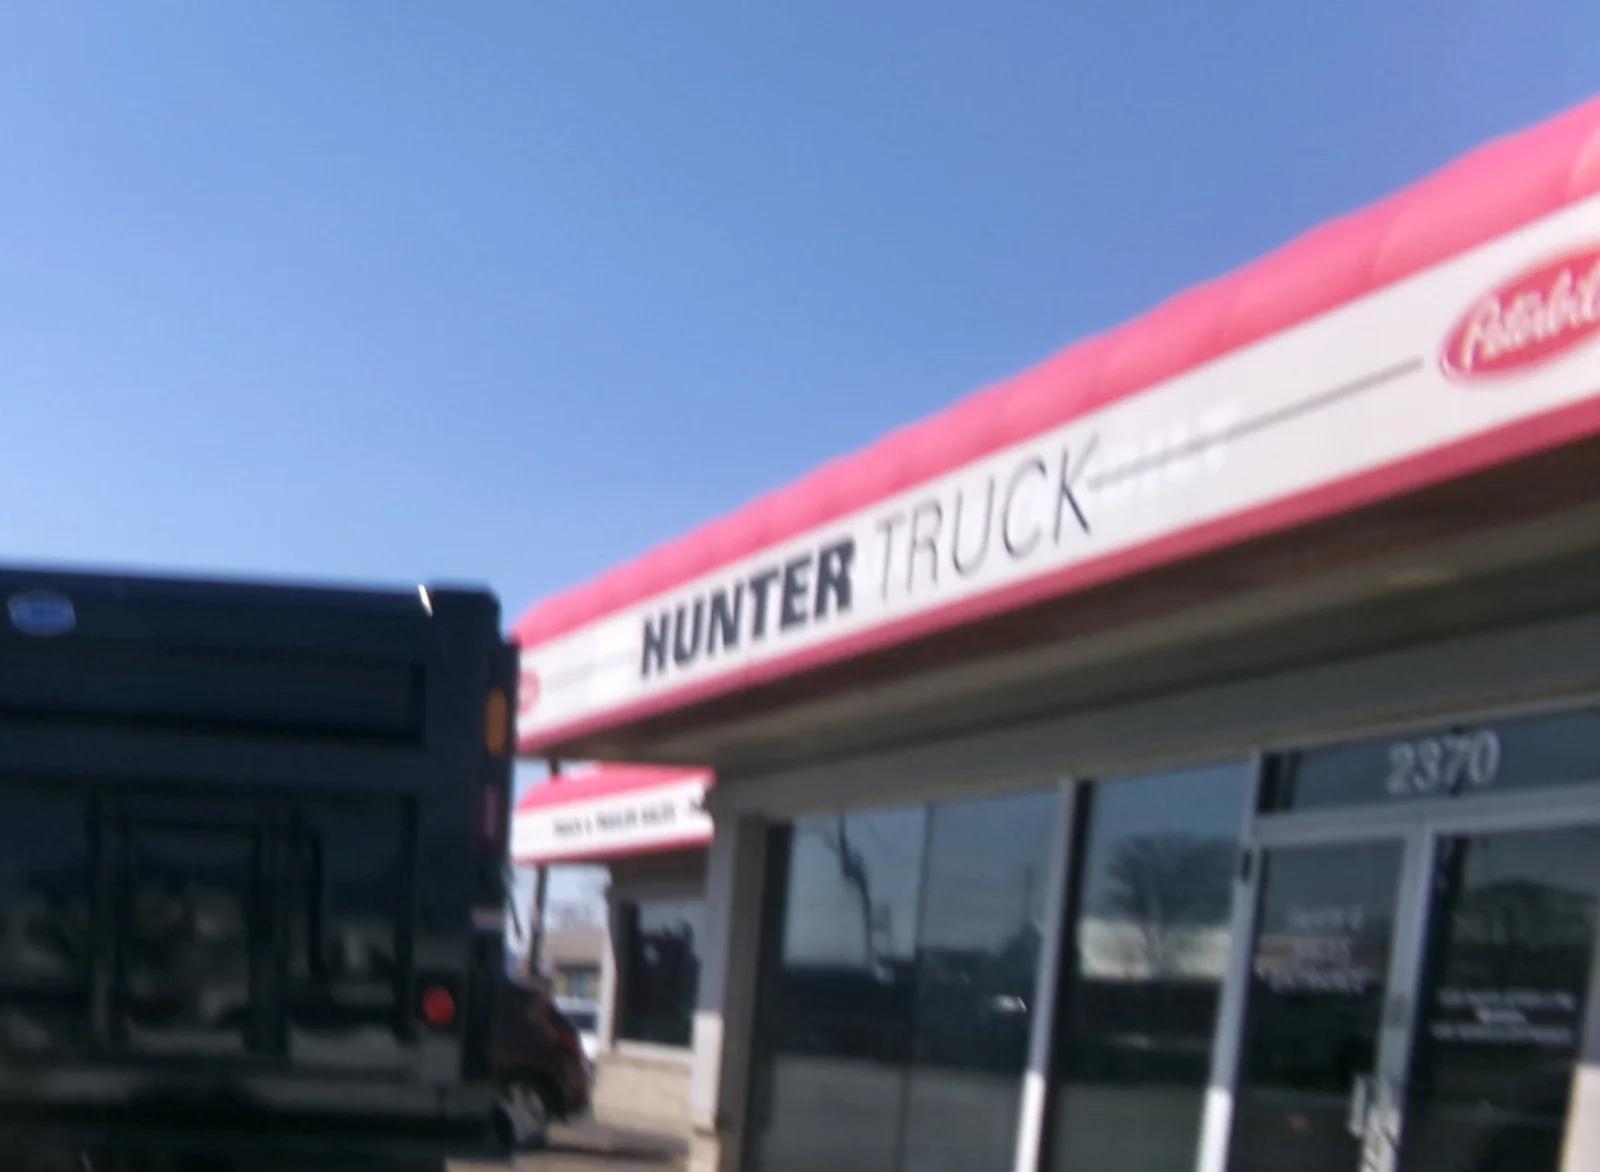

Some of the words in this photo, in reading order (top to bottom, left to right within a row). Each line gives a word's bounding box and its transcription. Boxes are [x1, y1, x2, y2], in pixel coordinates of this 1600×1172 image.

[640, 536, 856, 679] HUNTER
[875, 431, 1099, 603] TRUCK
[1385, 730, 1499, 795] 2370
